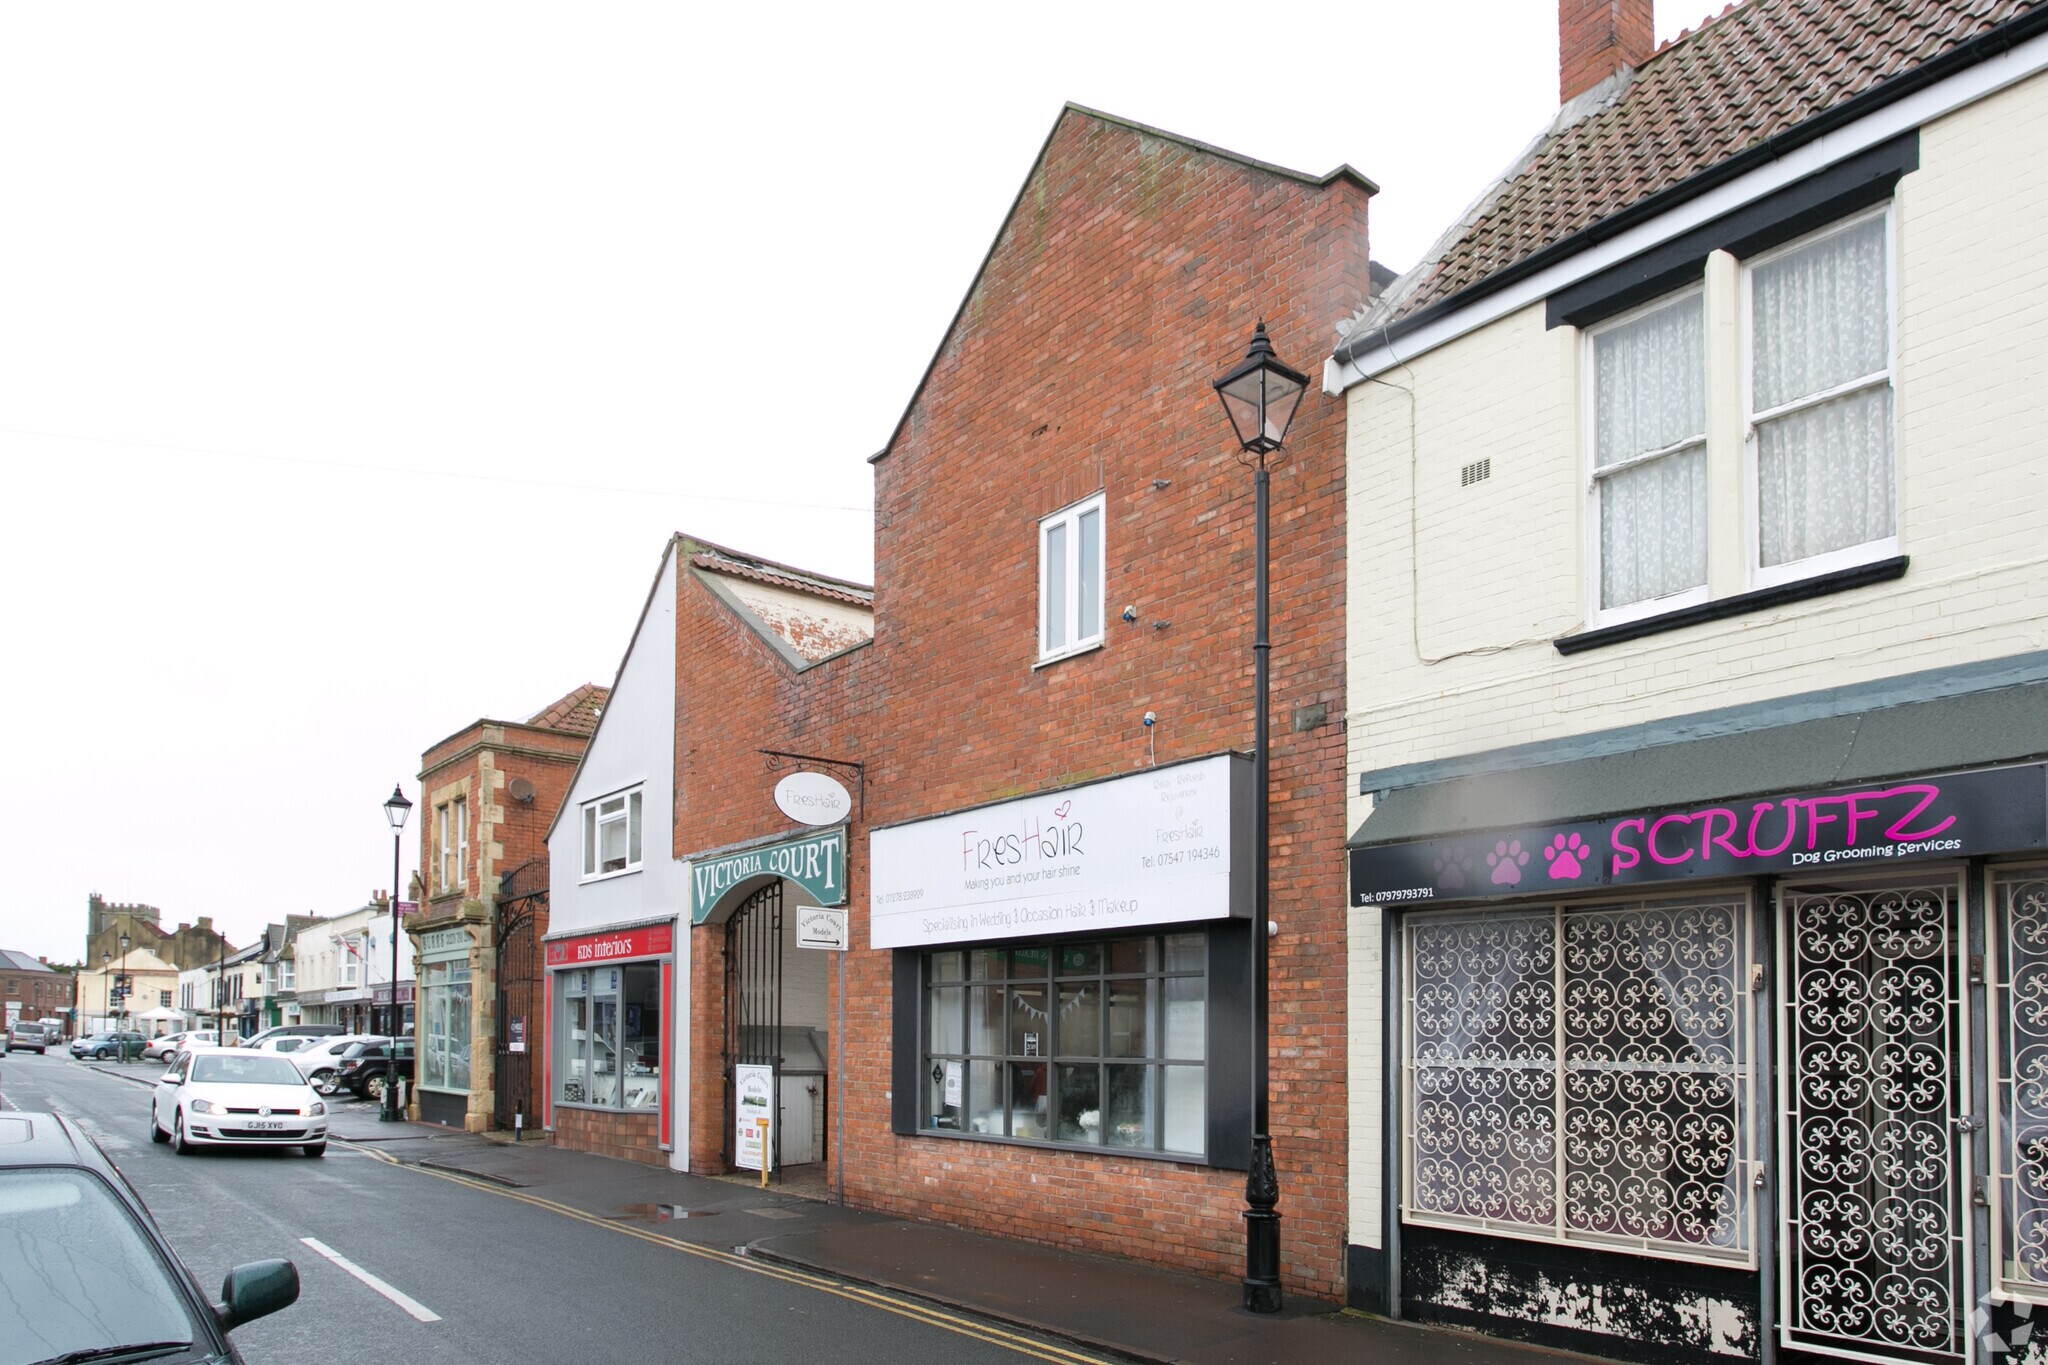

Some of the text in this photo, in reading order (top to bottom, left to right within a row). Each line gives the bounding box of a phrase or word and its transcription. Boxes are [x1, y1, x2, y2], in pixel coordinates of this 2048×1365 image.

[1611, 784, 1956, 876] SCRUFFZ
[1157, 851, 1184, 866] 07547
[1188, 846, 1220, 862] 194346
[1792, 838, 1962, 865] Dog Grooming Services
[695, 837, 839, 909] VICTORIA COURT
[964, 865, 1080, 891] Making you and your hair shine
[1360, 887, 1434, 903] Tel: 07979793791
[801, 912, 842, 932] Victoria Court
[970, 914, 978, 928] in
[979, 911, 1012, 929] Wedding
[1021, 905, 1062, 923] Occasion
[1098, 898, 1138, 915] Makeup
[812, 927, 832, 936] Models
[577, 945, 592, 960] KDS
[594, 935, 632, 958] interiors
